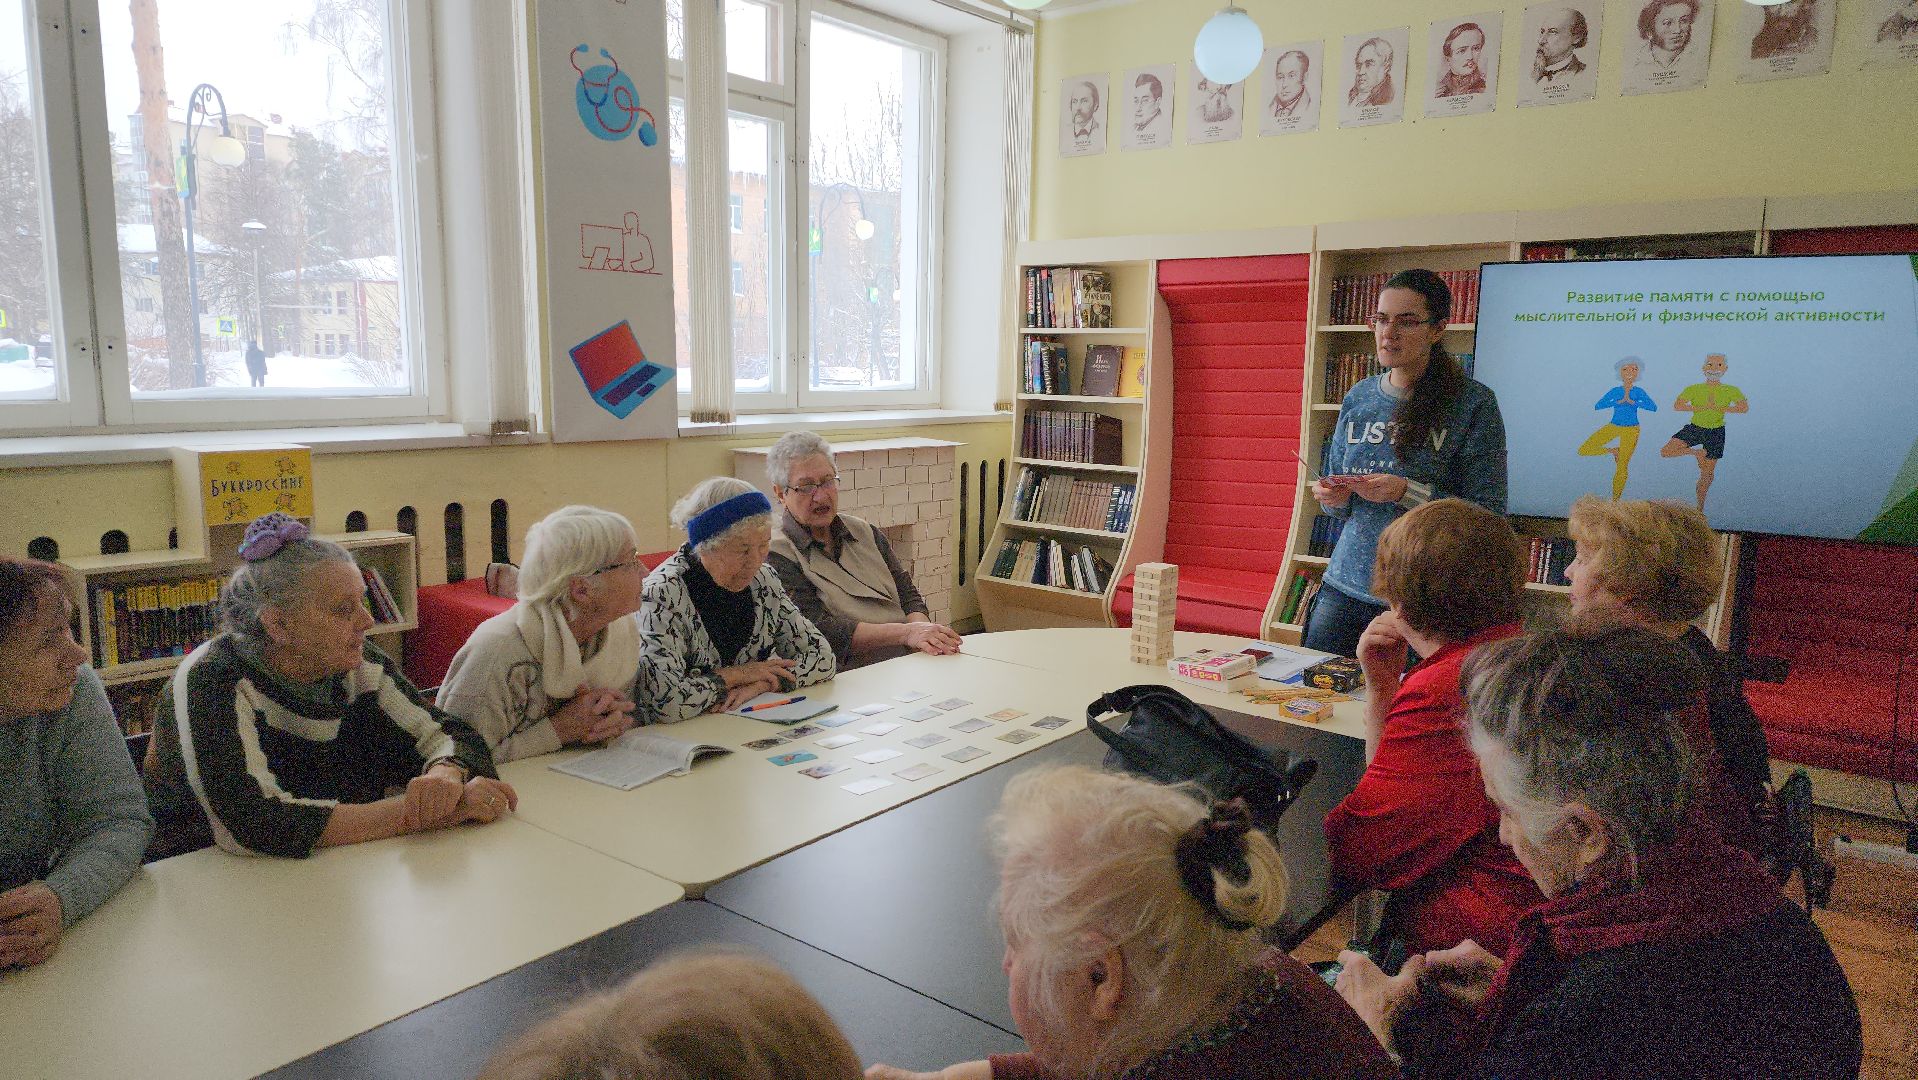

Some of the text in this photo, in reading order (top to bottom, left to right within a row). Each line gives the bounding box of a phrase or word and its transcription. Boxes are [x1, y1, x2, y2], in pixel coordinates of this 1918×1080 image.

[1566, 290, 1825, 304] Развитие памяти с помощью
[1514, 308, 1885, 324] мыслительной и физической активности
